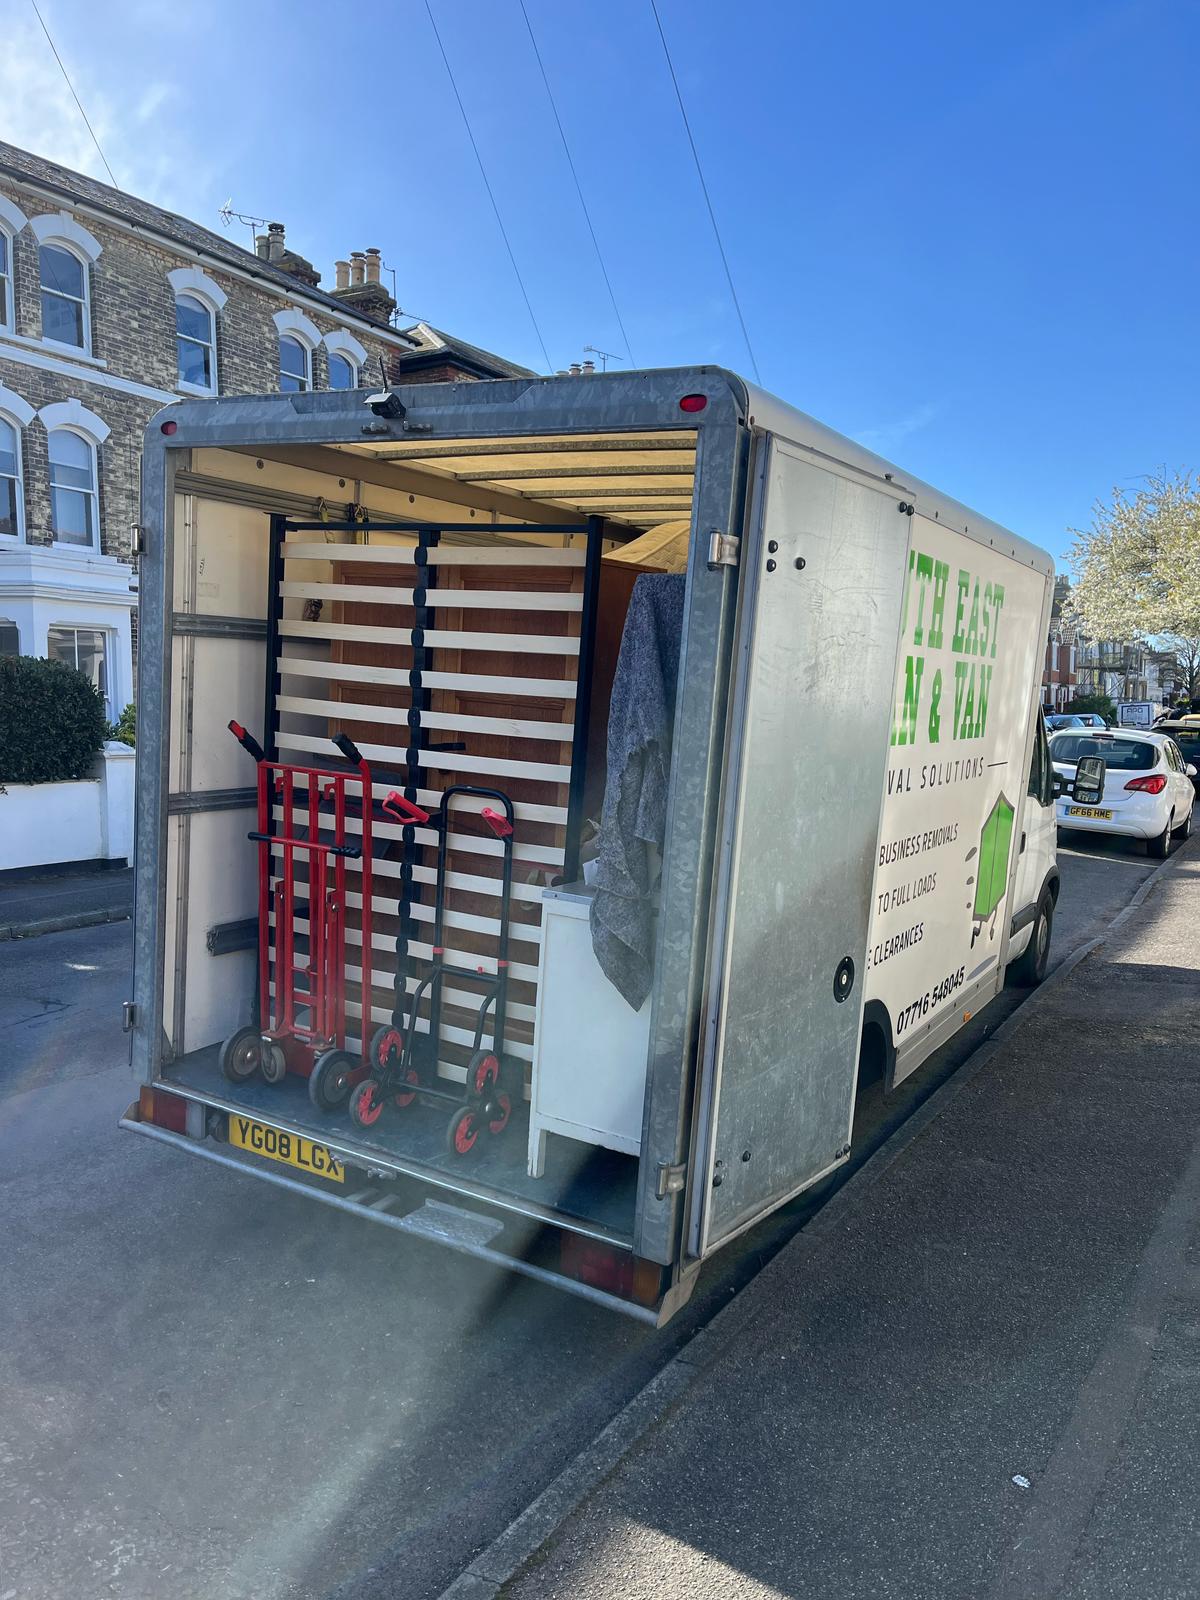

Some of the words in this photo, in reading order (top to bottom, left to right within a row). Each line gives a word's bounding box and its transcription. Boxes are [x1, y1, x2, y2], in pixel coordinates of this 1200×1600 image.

[952, 569, 1005, 659] EAST
[928, 668, 942, 743] &
[953, 661, 992, 740] VAN
[888, 767, 911, 795] VAL
[920, 757, 984, 789] SOLUTIONS
[1070, 807, 1092, 817] GF66
[879, 834, 921, 866] BUSINESS
[921, 823, 958, 852] REMOVALS
[878, 892, 890, 915] TO
[891, 883, 910, 909] FULL
[912, 872, 937, 899] LOADS
[873, 922, 924, 966] CLEARANCES
[896, 993, 929, 1035] 07716
[931, 966, 965, 1008] 548045
[238, 1119, 291, 1159] YG08
[297, 1139, 339, 1176] LGX
